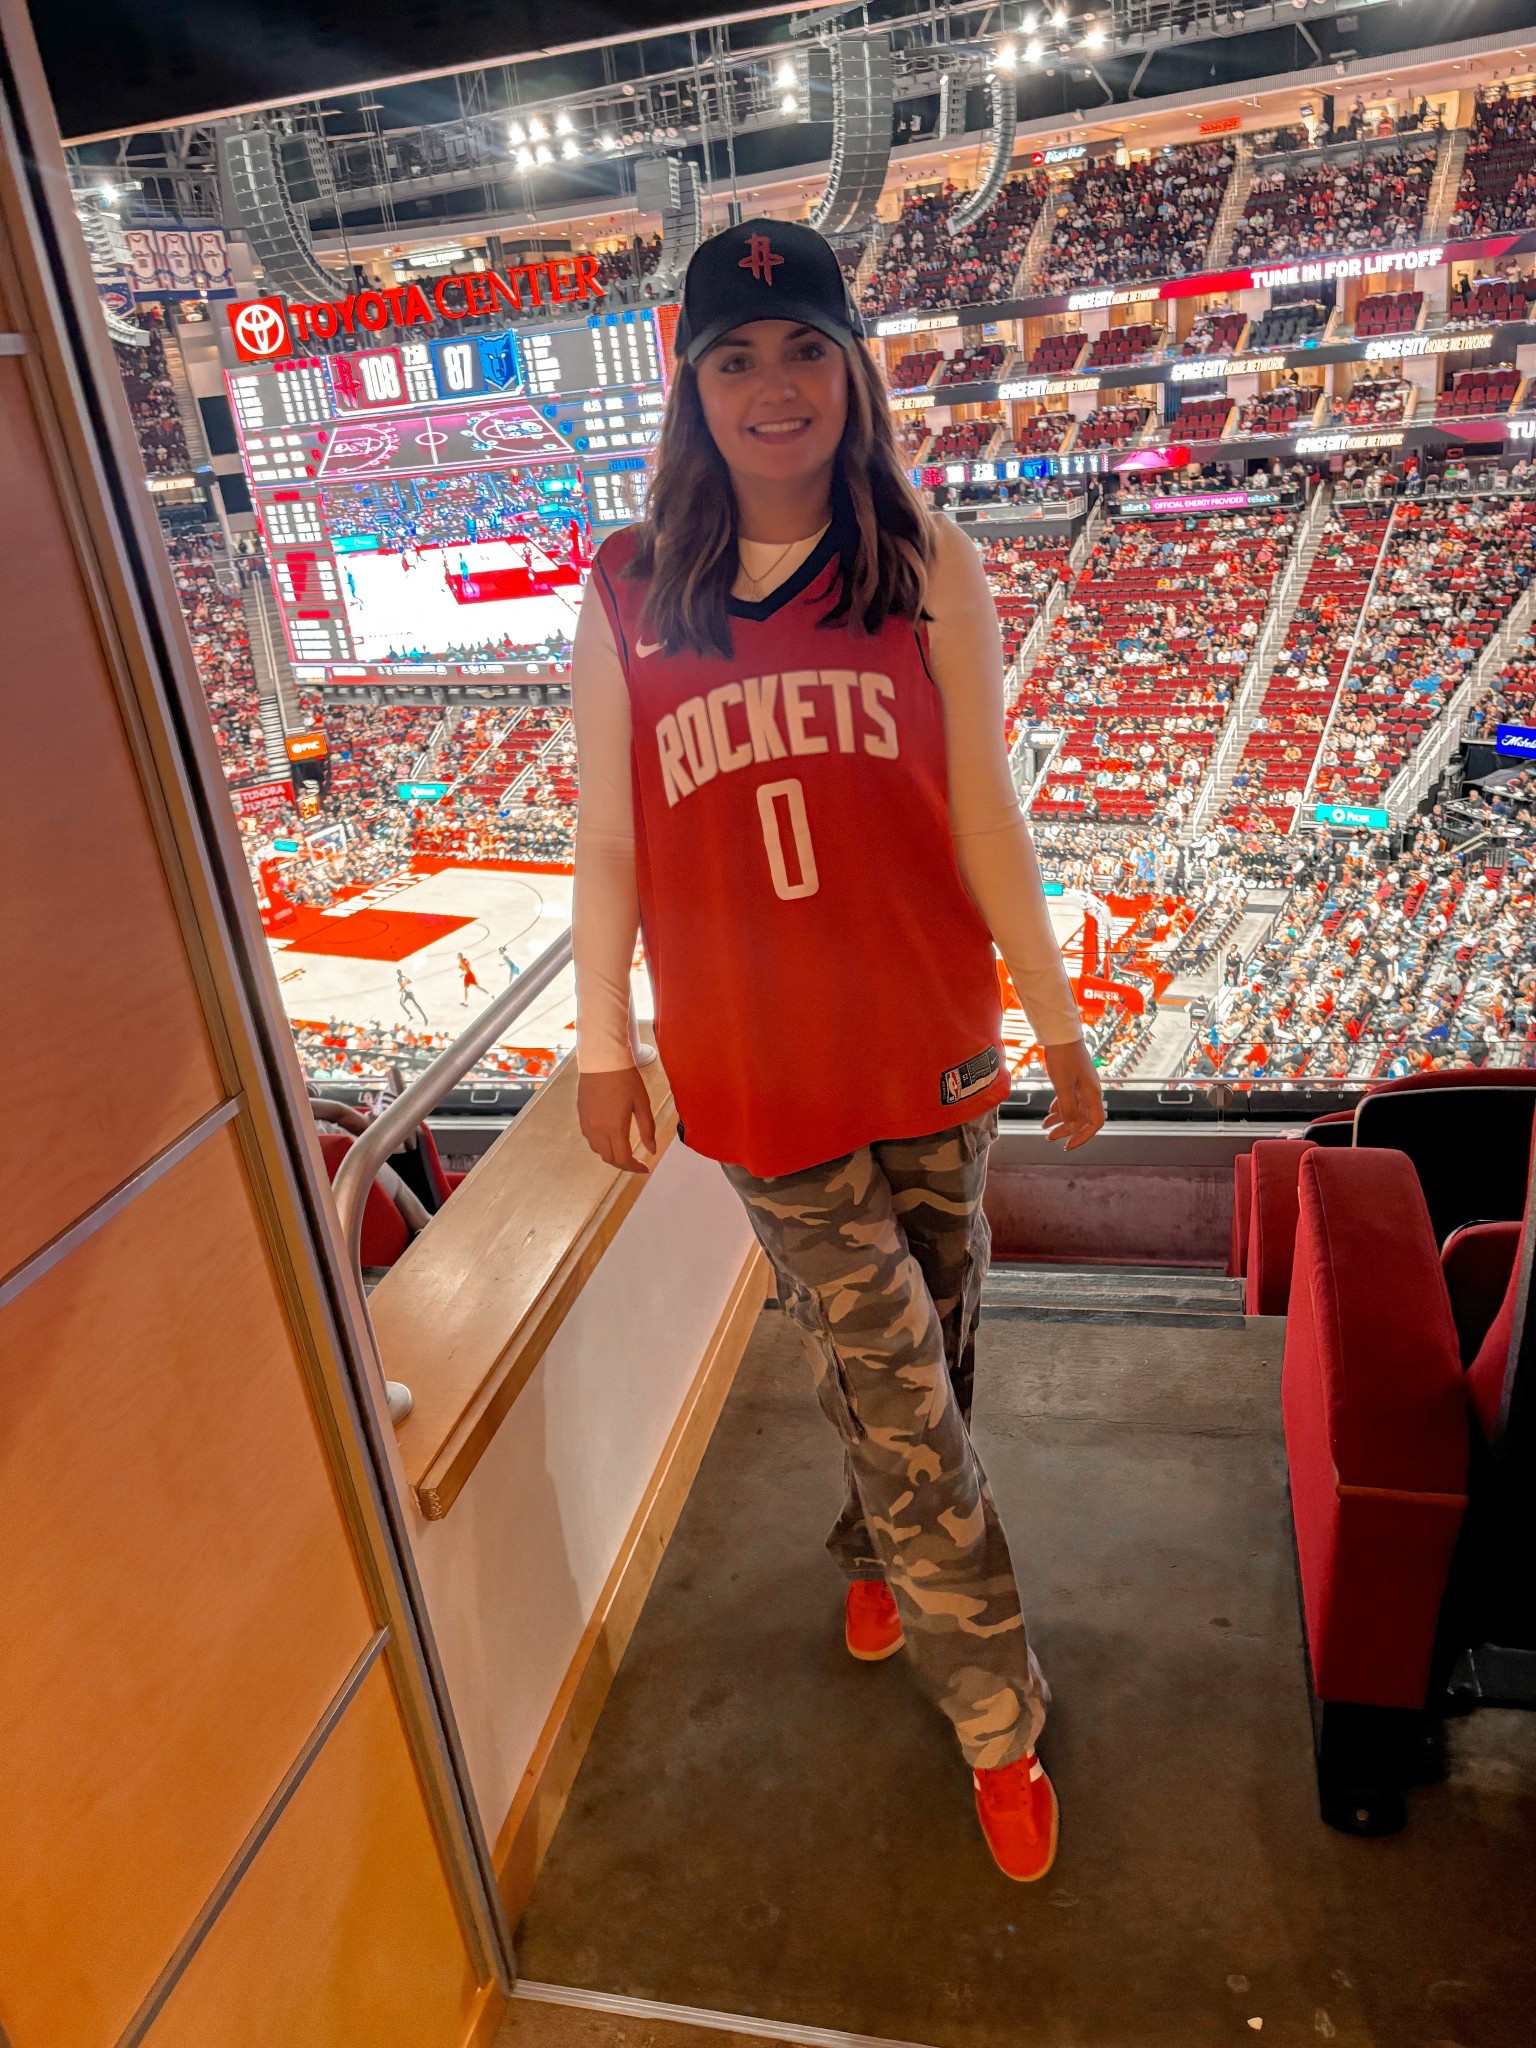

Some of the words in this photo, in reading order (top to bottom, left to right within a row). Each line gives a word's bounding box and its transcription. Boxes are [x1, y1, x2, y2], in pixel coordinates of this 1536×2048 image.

[1250, 266, 1300, 289] TUNE
[1302, 263, 1322, 283] IN
[1324, 258, 1363, 280] FOR
[1364, 248, 1443, 275] LIFTOFF
[288, 285, 436, 342] TOYOTA
[434, 255, 608, 320] CENTER
[443, 345, 473, 390] 87
[1365, 340, 1403, 359] SPACE
[1401, 336, 1429, 357] CITY
[359, 355, 401, 401] 108
[1507, 420, 1536, 438] TU
[1154, 501, 1184, 510] OFFICIAL
[1184, 499, 1211, 508] ENERGY
[1211, 496, 1244, 505] PROVIDER
[655, 669, 899, 809] ROCKETS
[756, 778, 820, 901] 0
